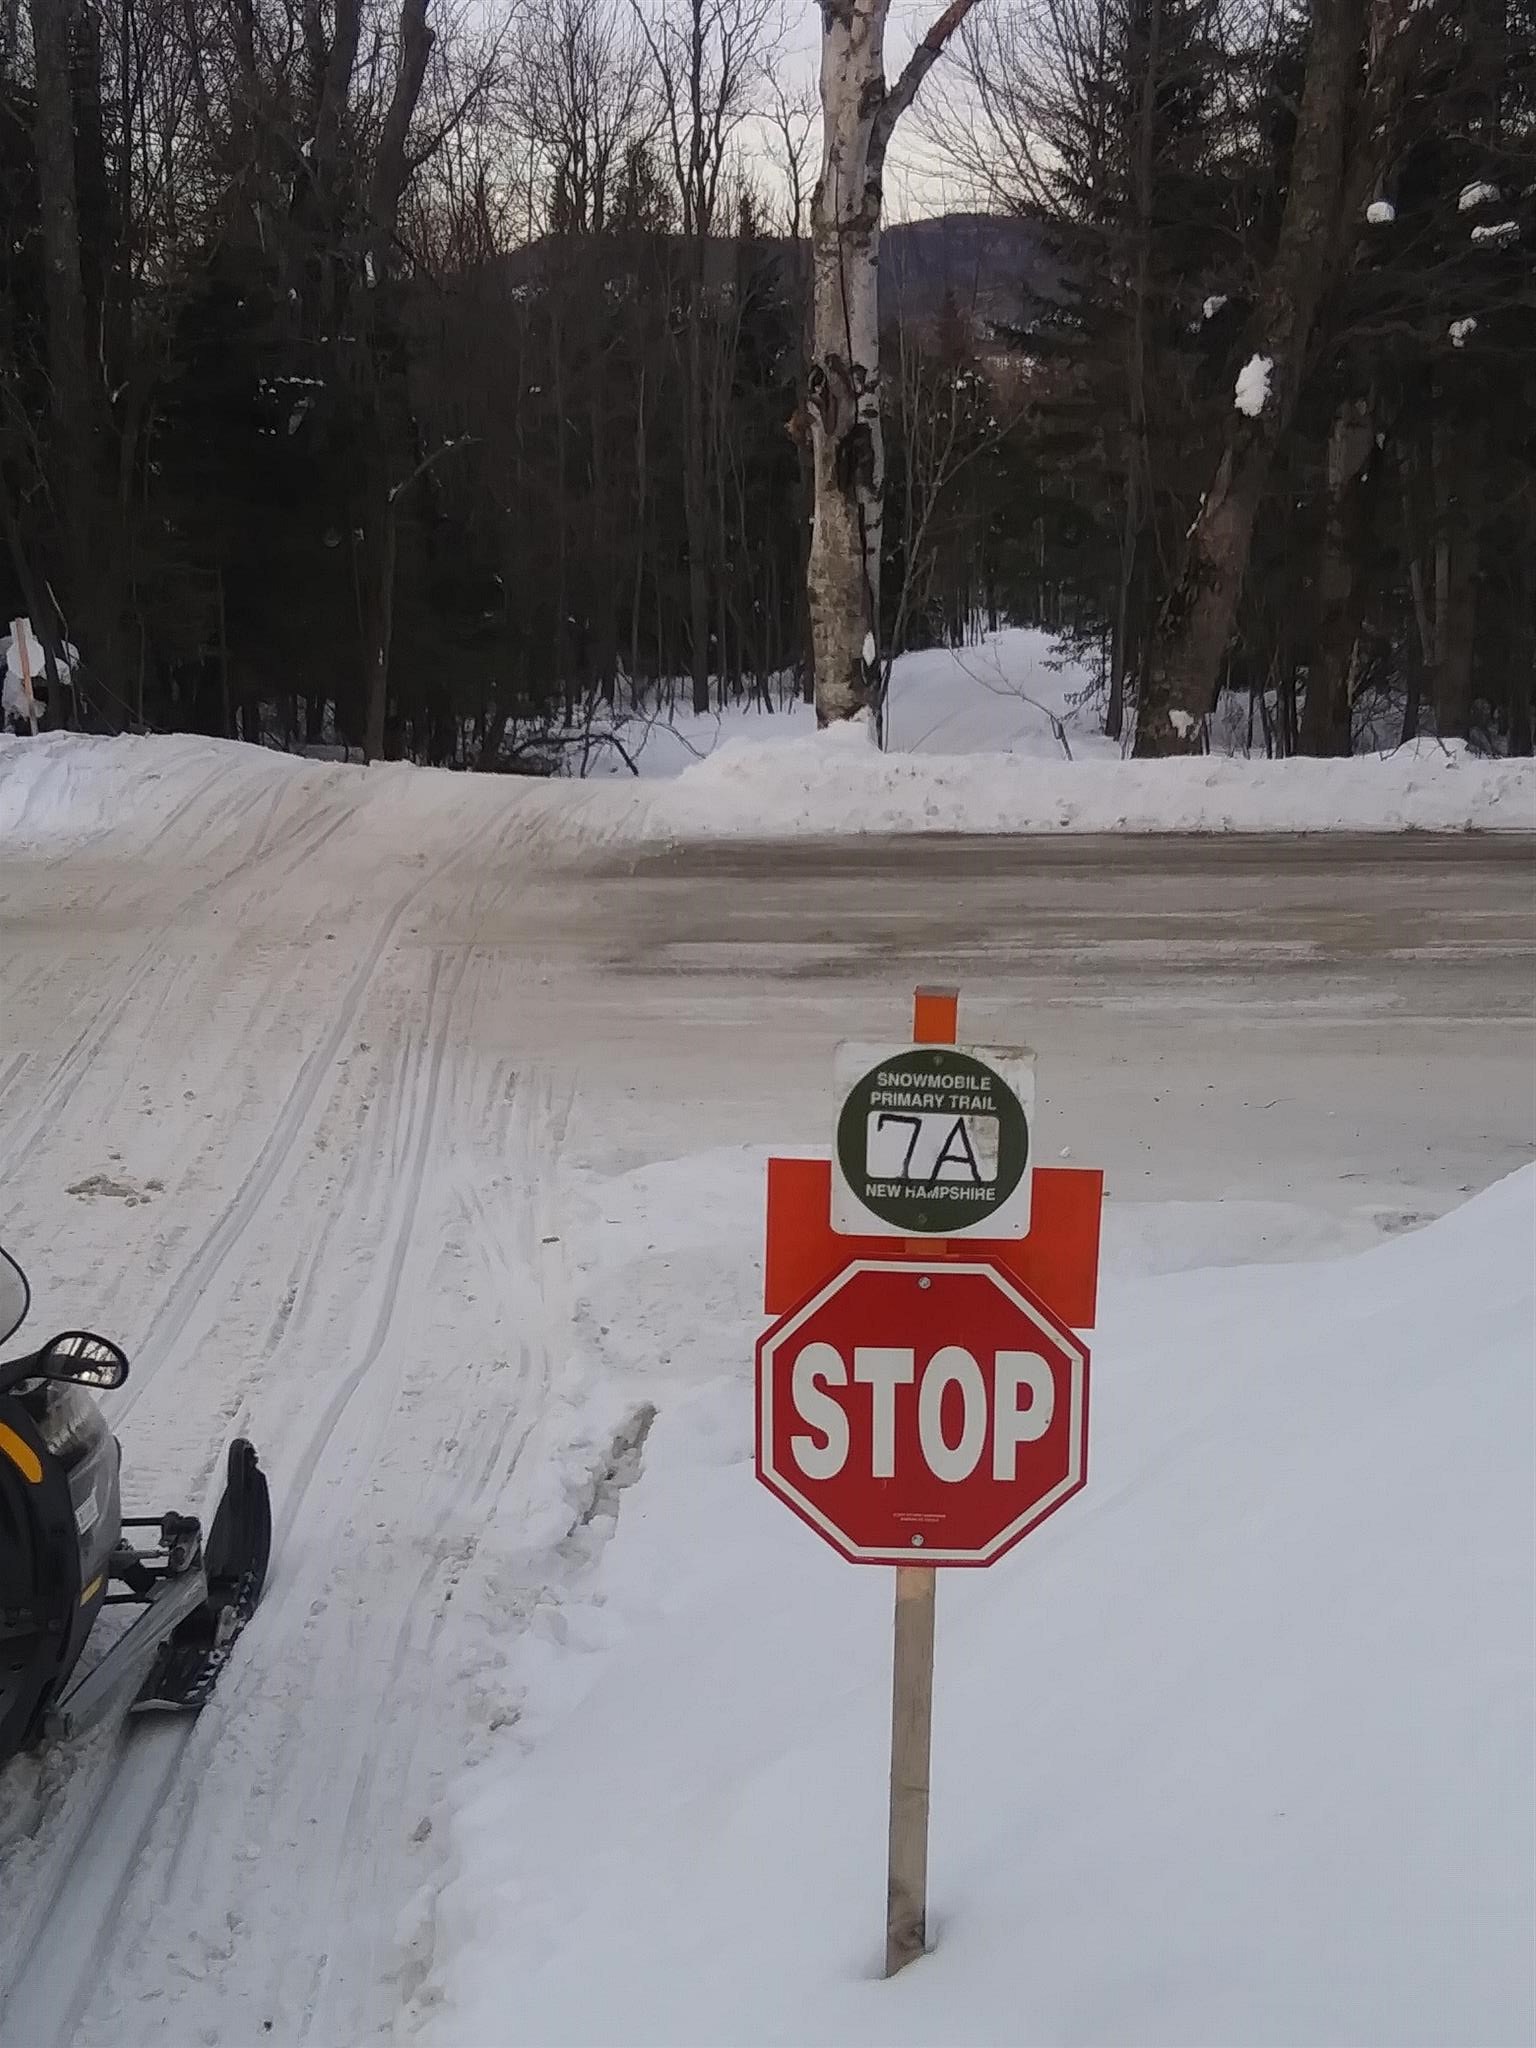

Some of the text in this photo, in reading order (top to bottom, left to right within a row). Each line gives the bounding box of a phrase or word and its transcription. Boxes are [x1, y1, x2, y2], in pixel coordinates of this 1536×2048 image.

[877, 1073, 991, 1090] SNOWMOBILE
[870, 1092, 996, 1110] PRIMARY TRAIL
[878, 1114, 982, 1183] 7A
[866, 1184, 995, 1200] NEW HAMPSHIRE
[790, 1342, 1055, 1482] STOP
